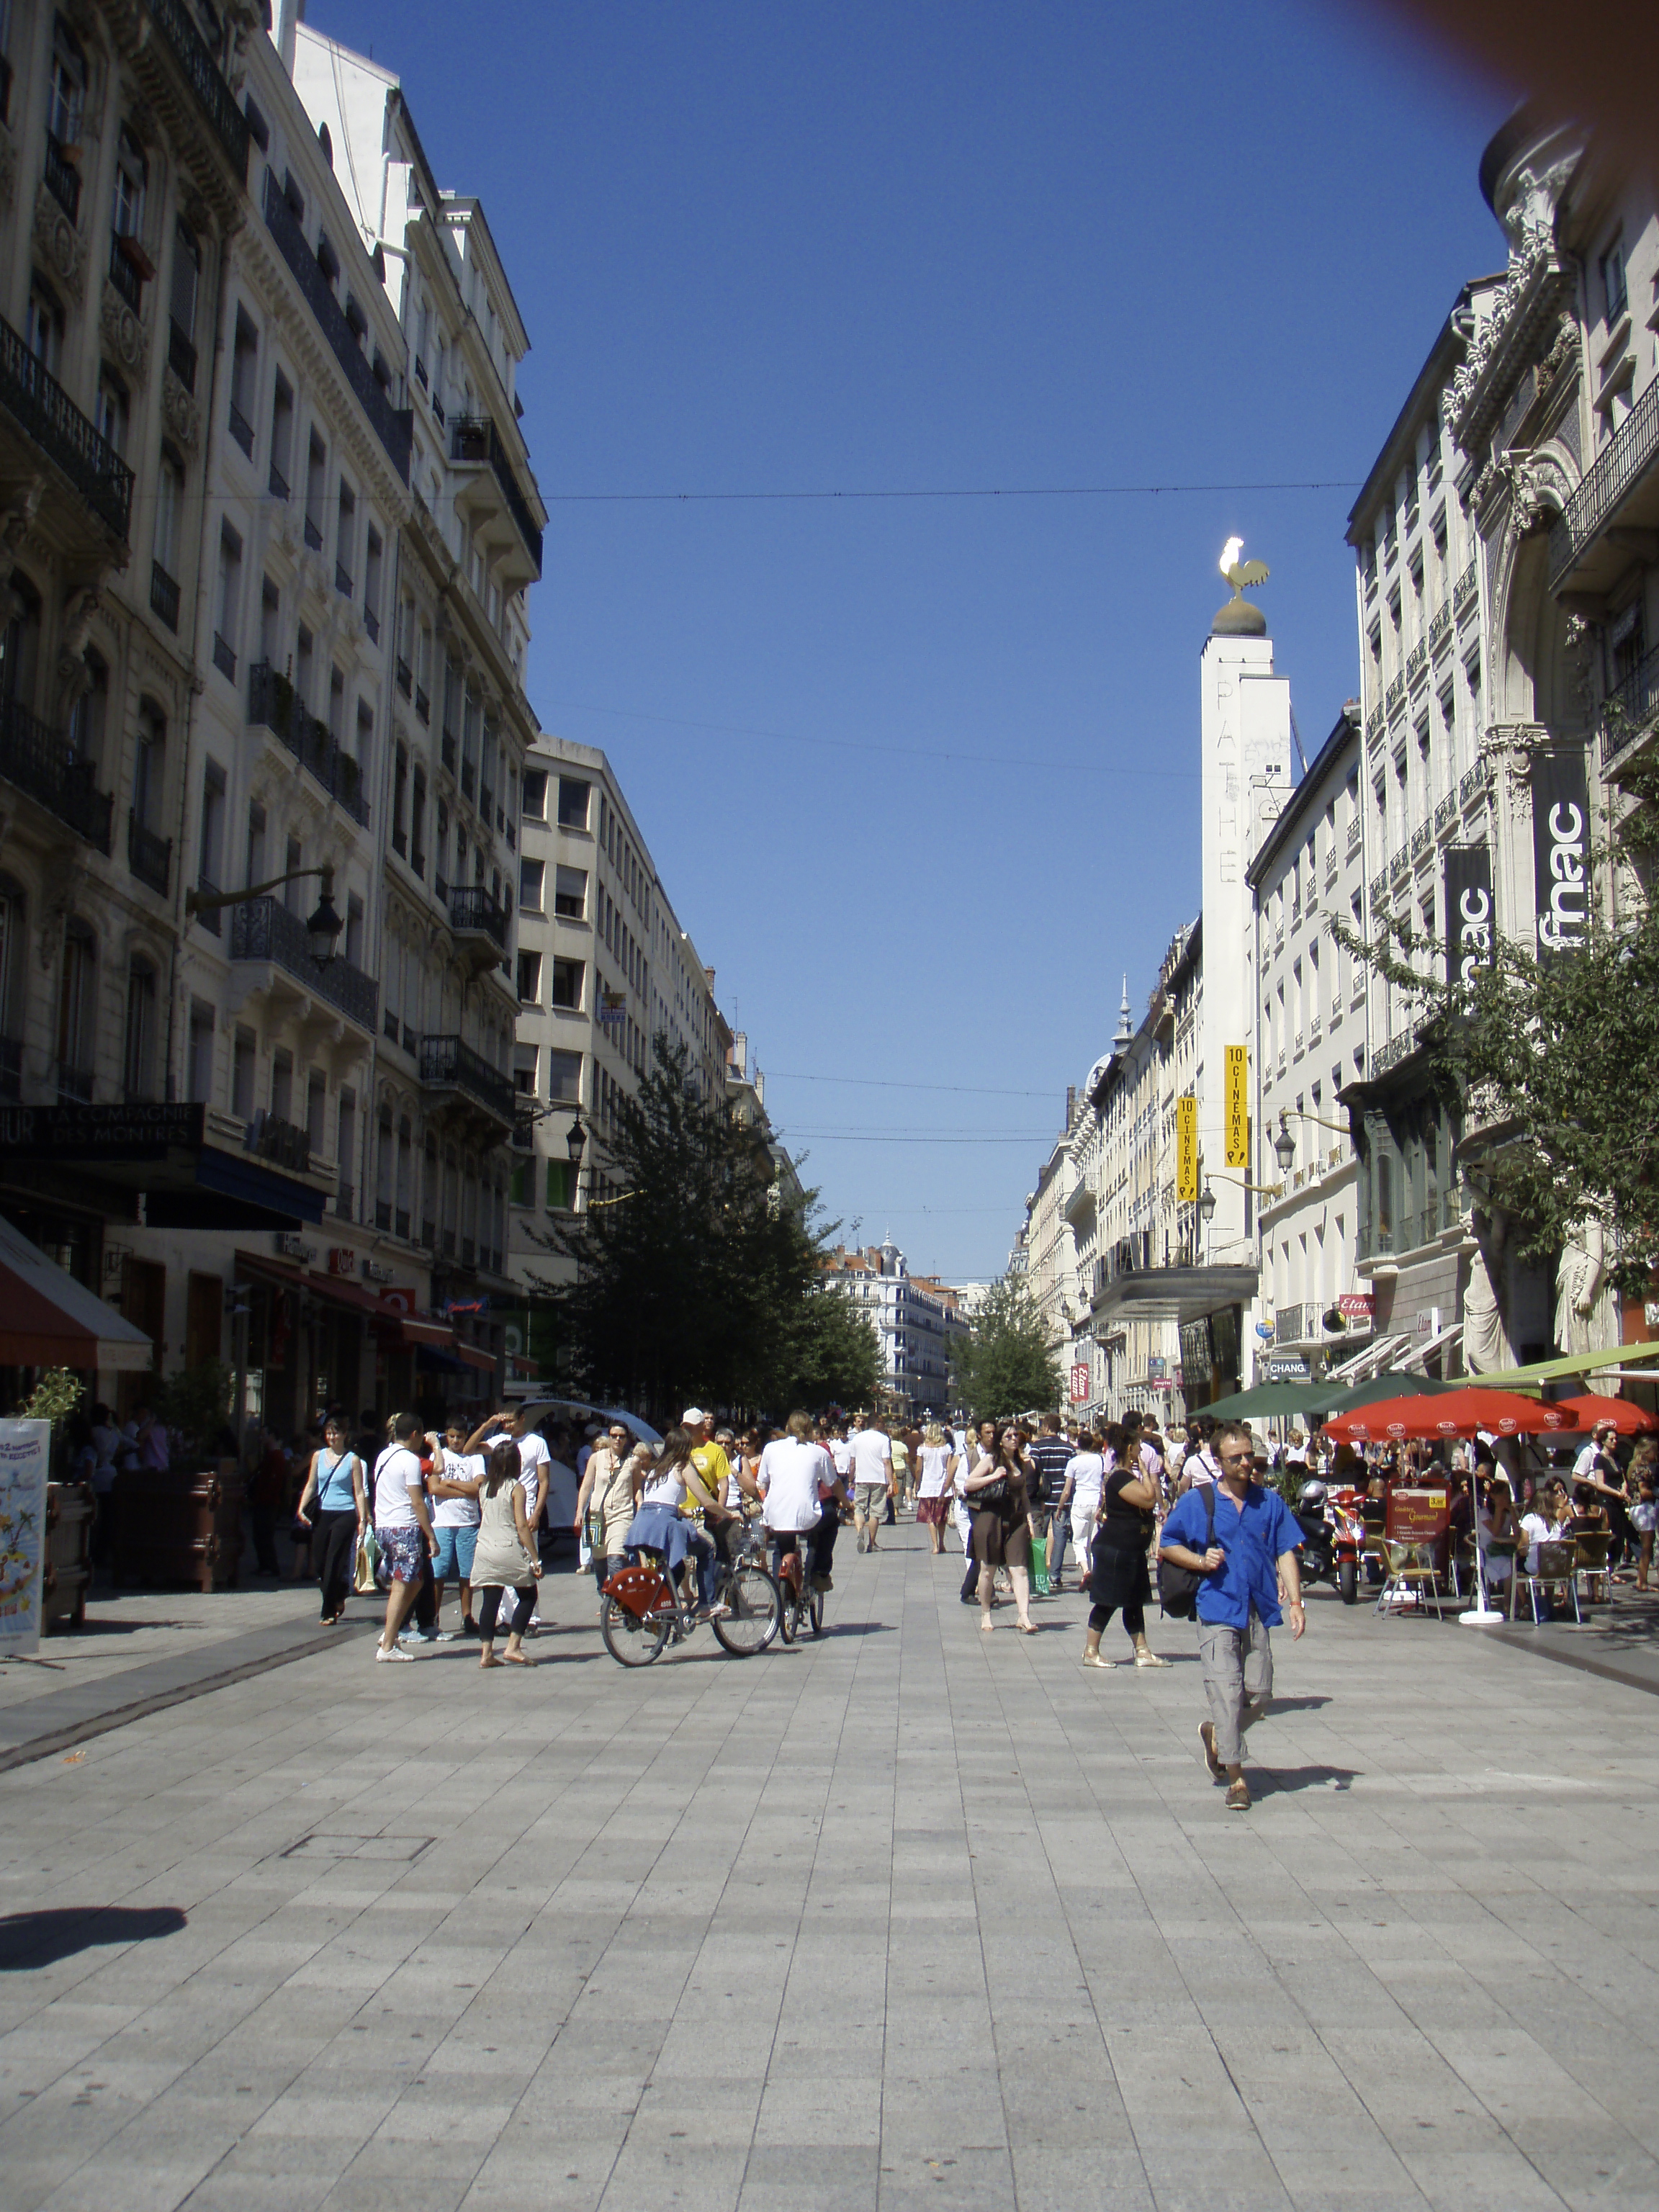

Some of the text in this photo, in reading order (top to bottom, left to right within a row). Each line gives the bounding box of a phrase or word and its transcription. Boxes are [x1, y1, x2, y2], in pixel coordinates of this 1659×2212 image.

[1539, 802, 1585, 952] fnac
[1229, 1048, 1243, 1062] 10
[48, 1105, 192, 1124] LA COMPAGNIE
[1181, 1100, 1192, 1112] 10
[1231, 1065, 1241, 1150] CINÉMAS
[53, 1125, 188, 1143] DES MONTRES
[1183, 1115, 1192, 1185] CINÉMAS
[1341, 1298, 1375, 1310] Etam
[1079, 1367, 1088, 1396] Etam
